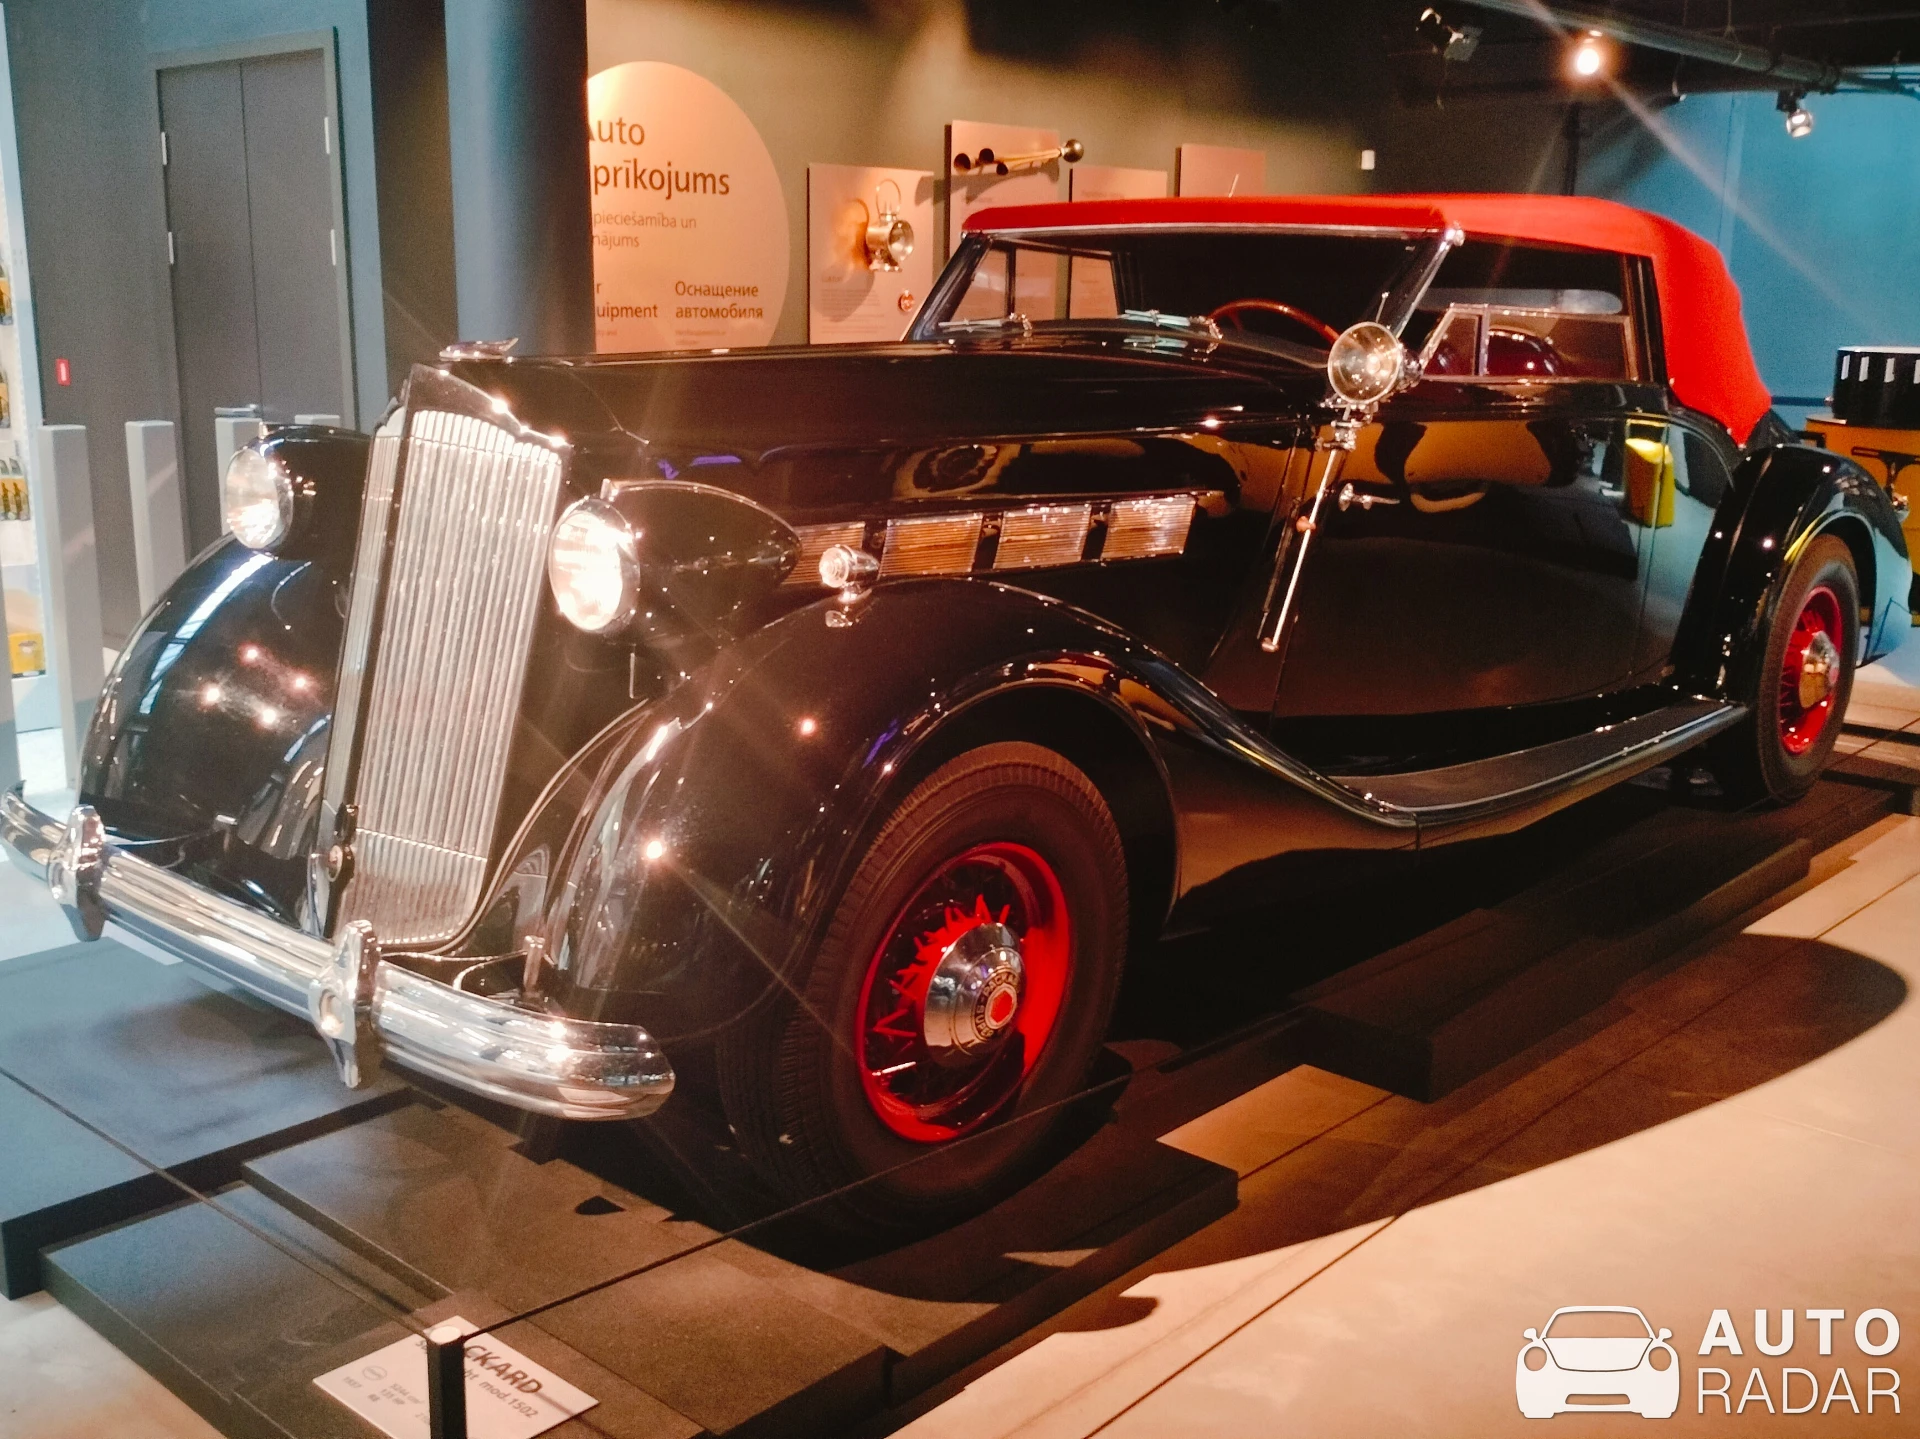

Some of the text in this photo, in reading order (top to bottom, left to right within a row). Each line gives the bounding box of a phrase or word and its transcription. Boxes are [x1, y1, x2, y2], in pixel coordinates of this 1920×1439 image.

[593, 158, 730, 200] prīkojums
[593, 211, 697, 229] pieciešamība un
[592, 231, 640, 250] nājums
[674, 280, 759, 298] Оснащение
[596, 302, 658, 322] uipment
[675, 302, 764, 320] автомобиля
[464, 1345, 543, 1394] CKARD
